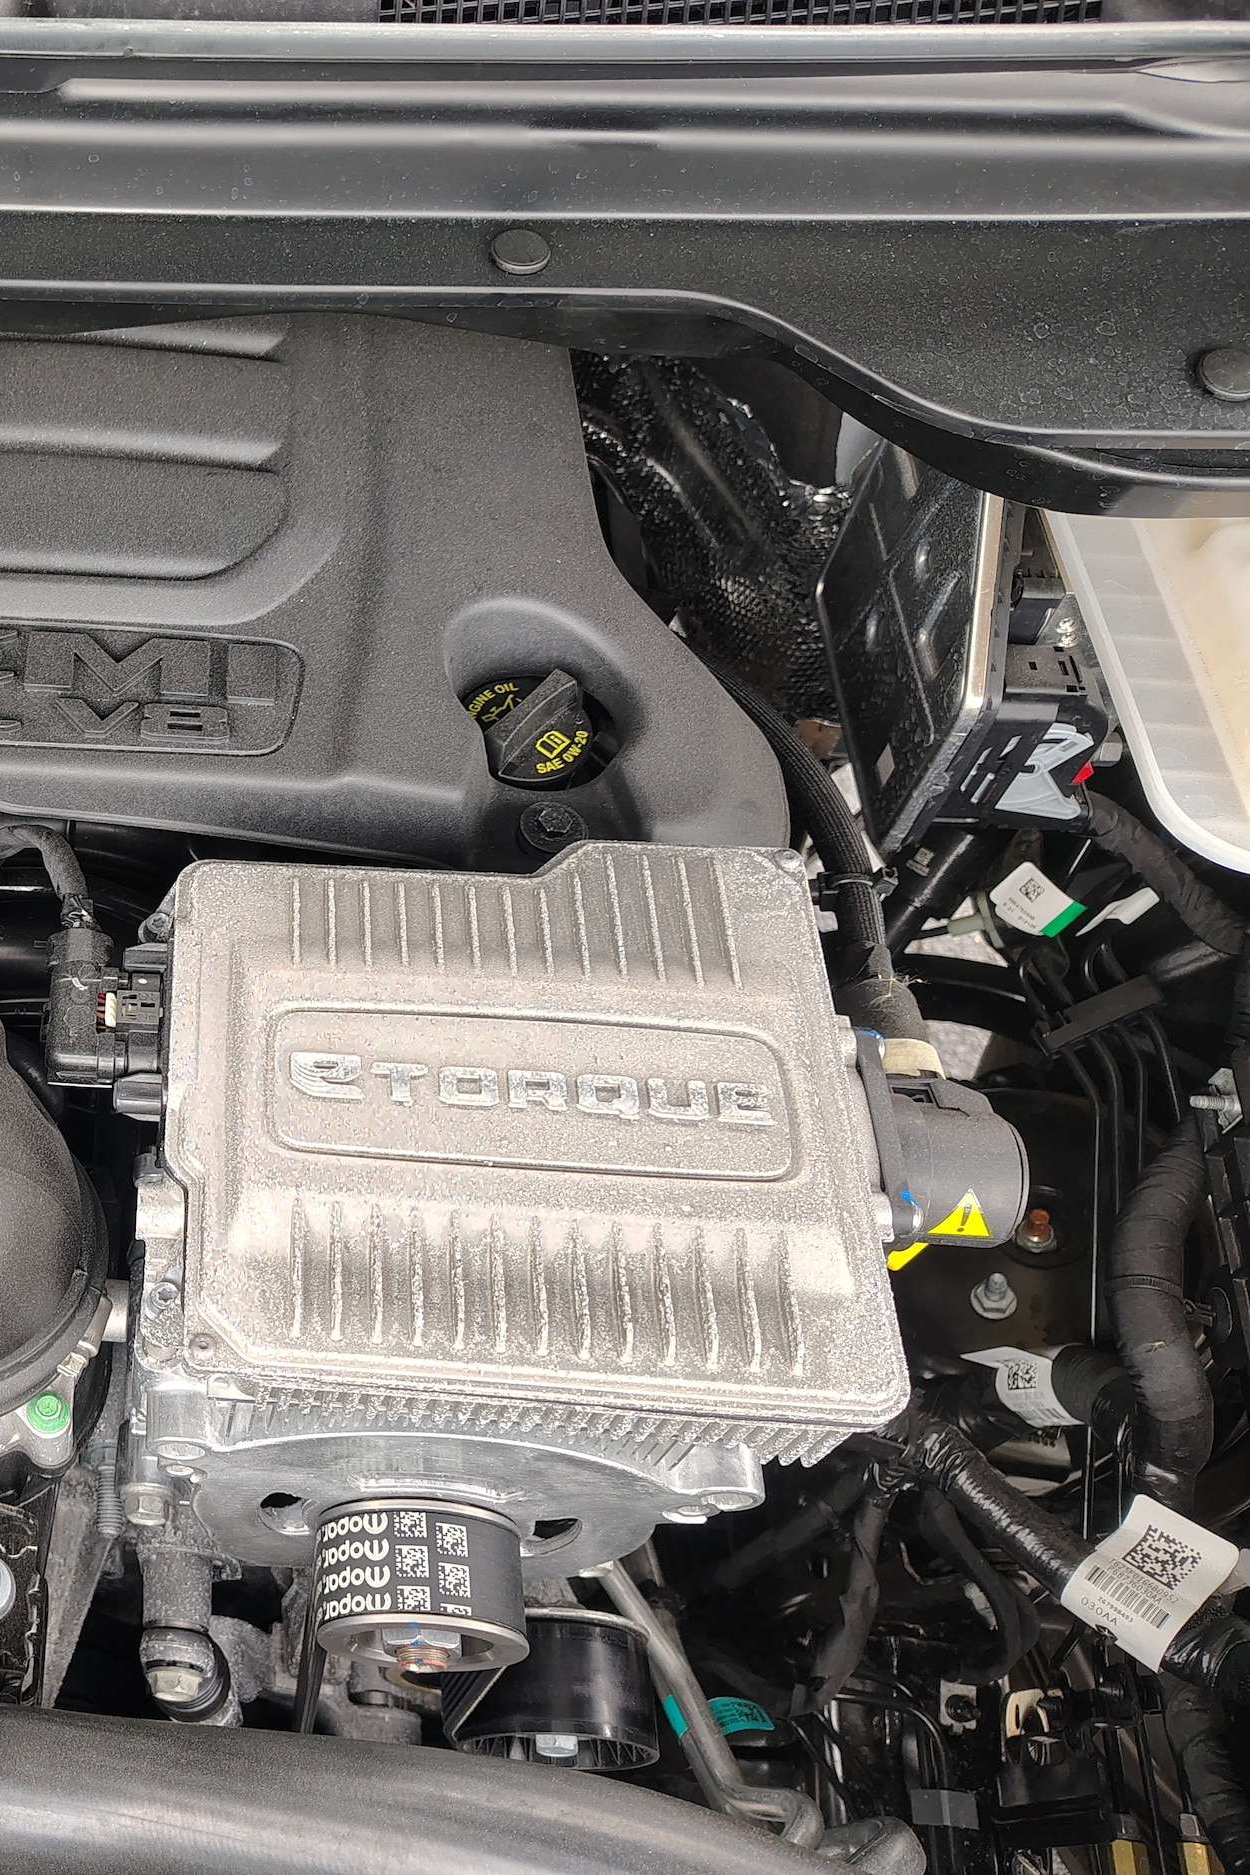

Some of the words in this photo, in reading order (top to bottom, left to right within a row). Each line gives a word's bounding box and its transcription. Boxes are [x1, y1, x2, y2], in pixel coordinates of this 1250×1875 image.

[53, 696, 230, 744] V8
[466, 690, 496, 719] NGINE
[494, 682, 519, 694] OIL
[536, 758, 565, 774] SAE
[562, 730, 589, 762] 0W-20
[1081, 1597, 1118, 1626] 030AA
